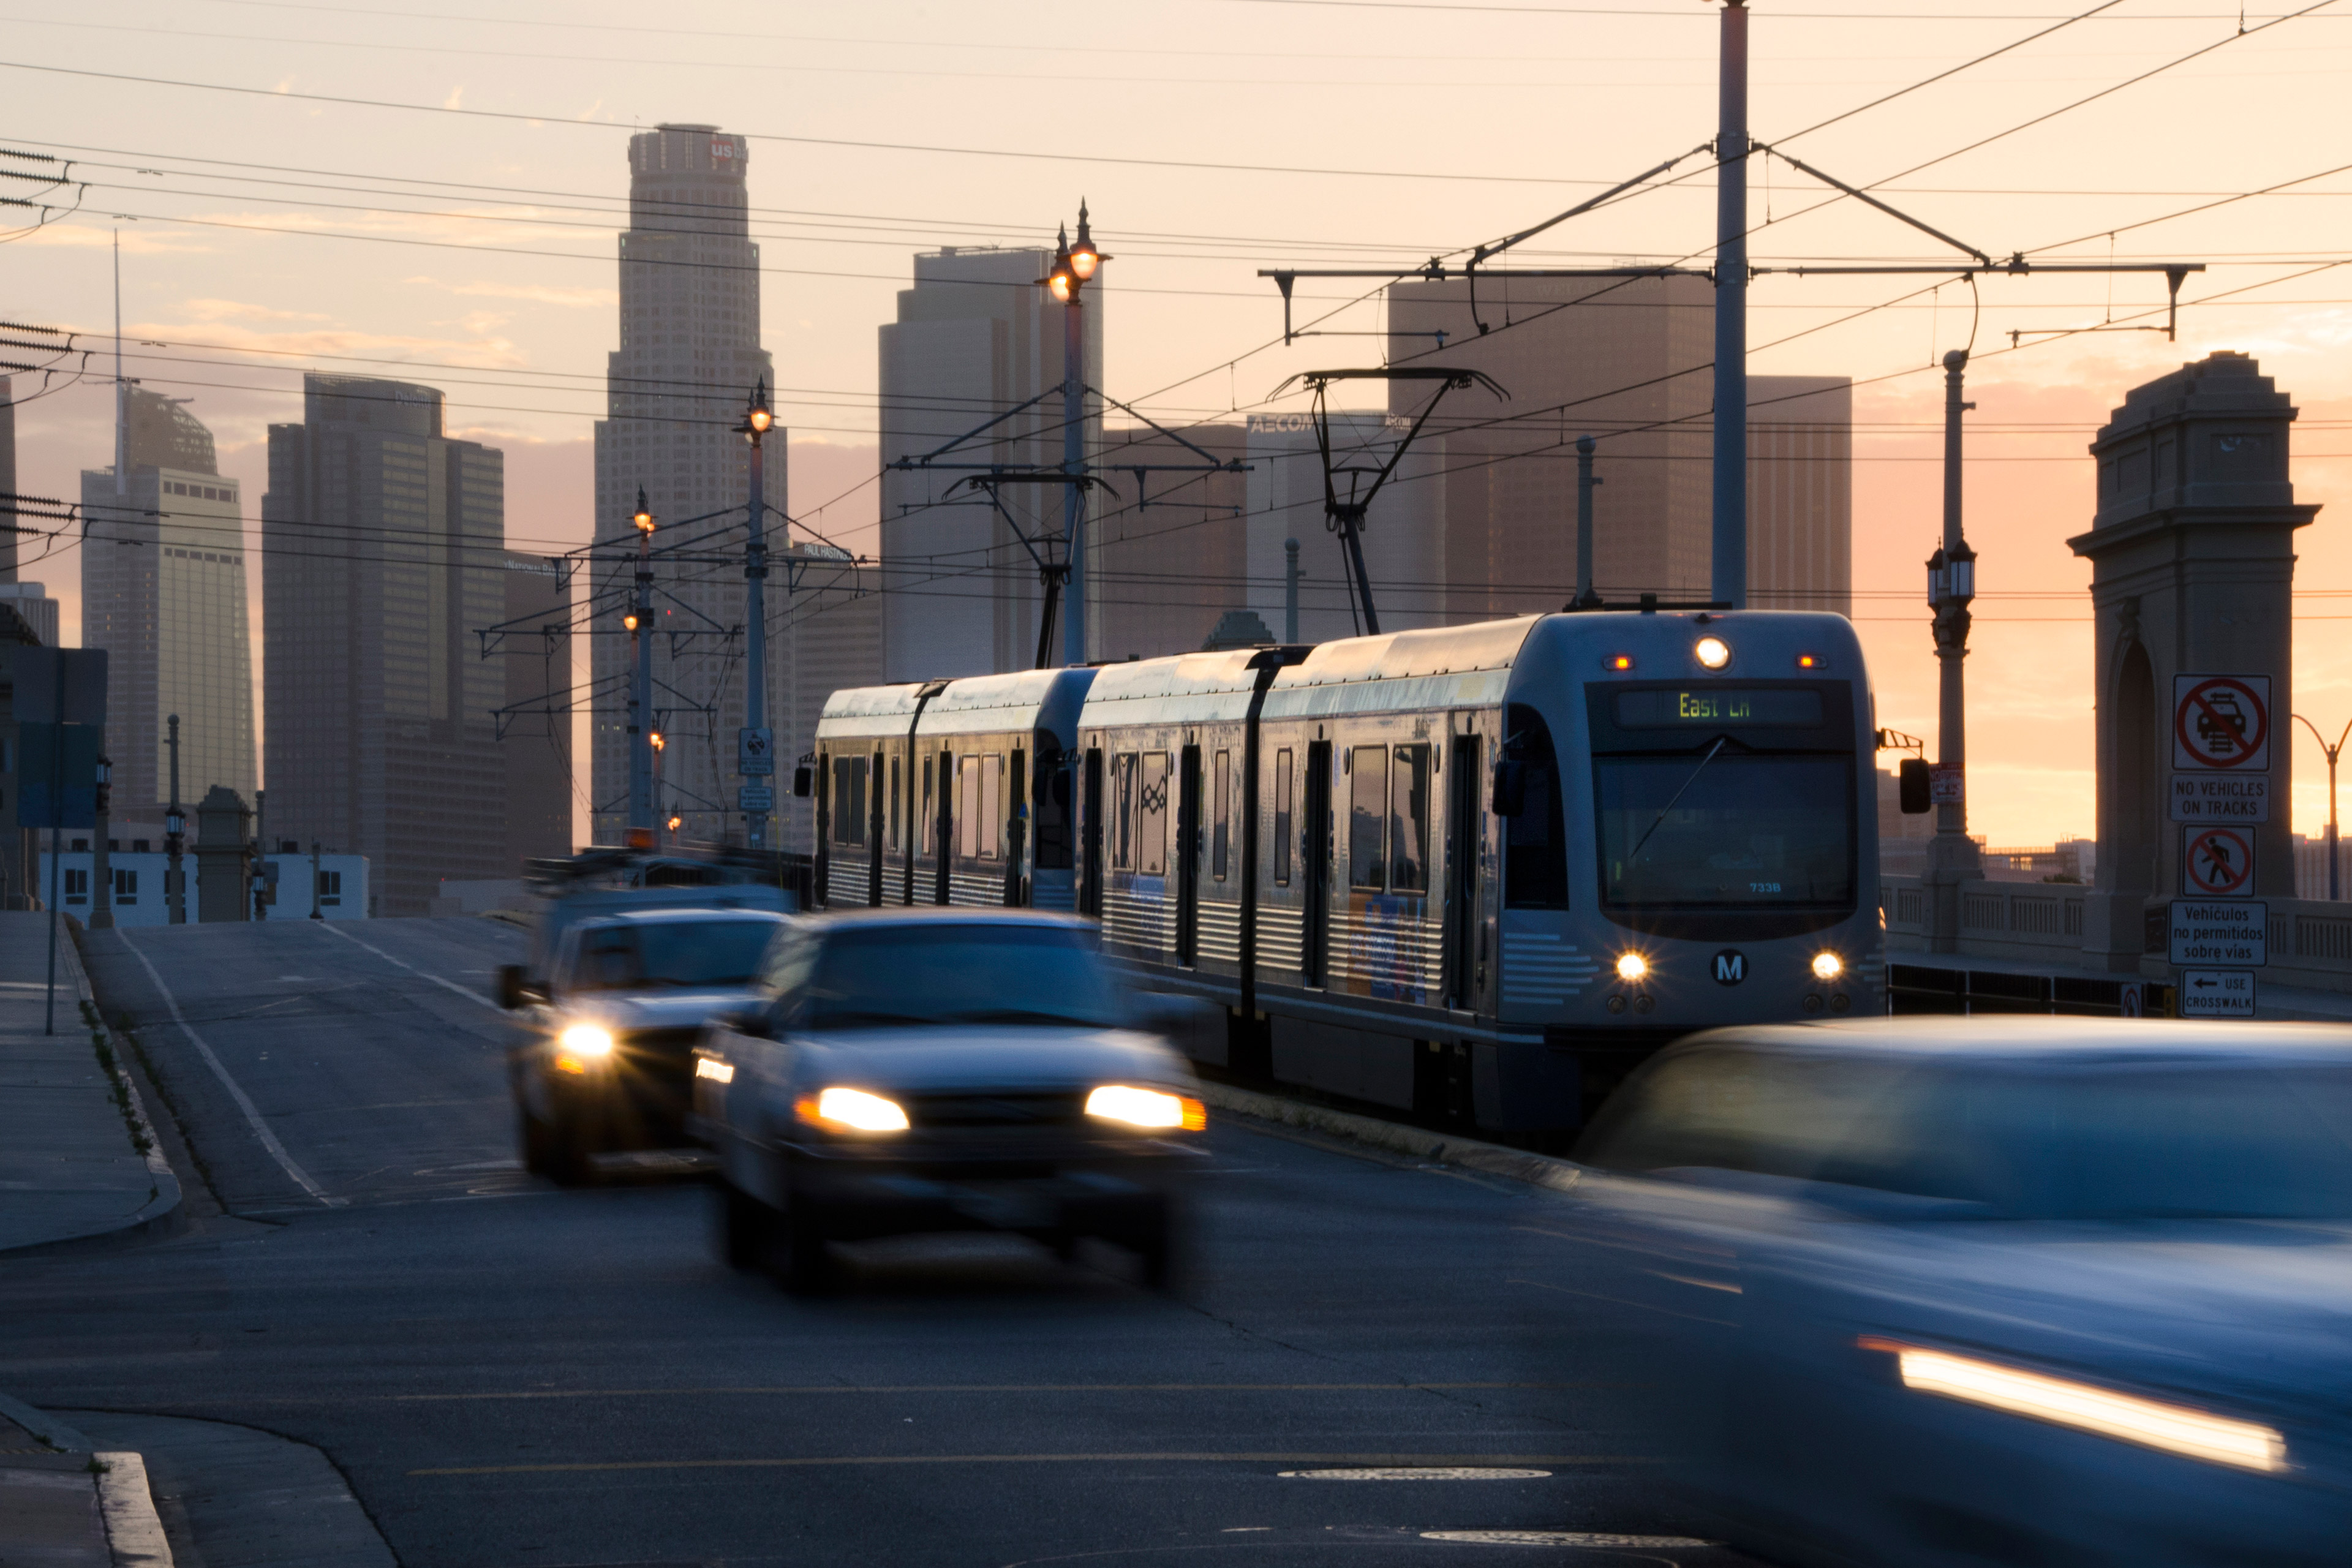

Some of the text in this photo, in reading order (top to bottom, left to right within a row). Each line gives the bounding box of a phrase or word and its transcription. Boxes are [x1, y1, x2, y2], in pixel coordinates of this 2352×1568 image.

[1250, 415, 1317, 433] AECOM
[804, 544, 820, 556] PAUL
[1680, 693, 1718, 717] East
[2176, 782, 2264, 796] NO VEHICLES
[2182, 800, 2257, 815] ON TRACKS
[2185, 906, 2249, 921] Vehículos
[2174, 925, 2263, 942] no permitidos
[2184, 943, 2252, 959] sobre vías
[1717, 955, 1741, 980] M
[2225, 978, 2246, 990] USE
[2186, 997, 2252, 1008] CROSSWALK
